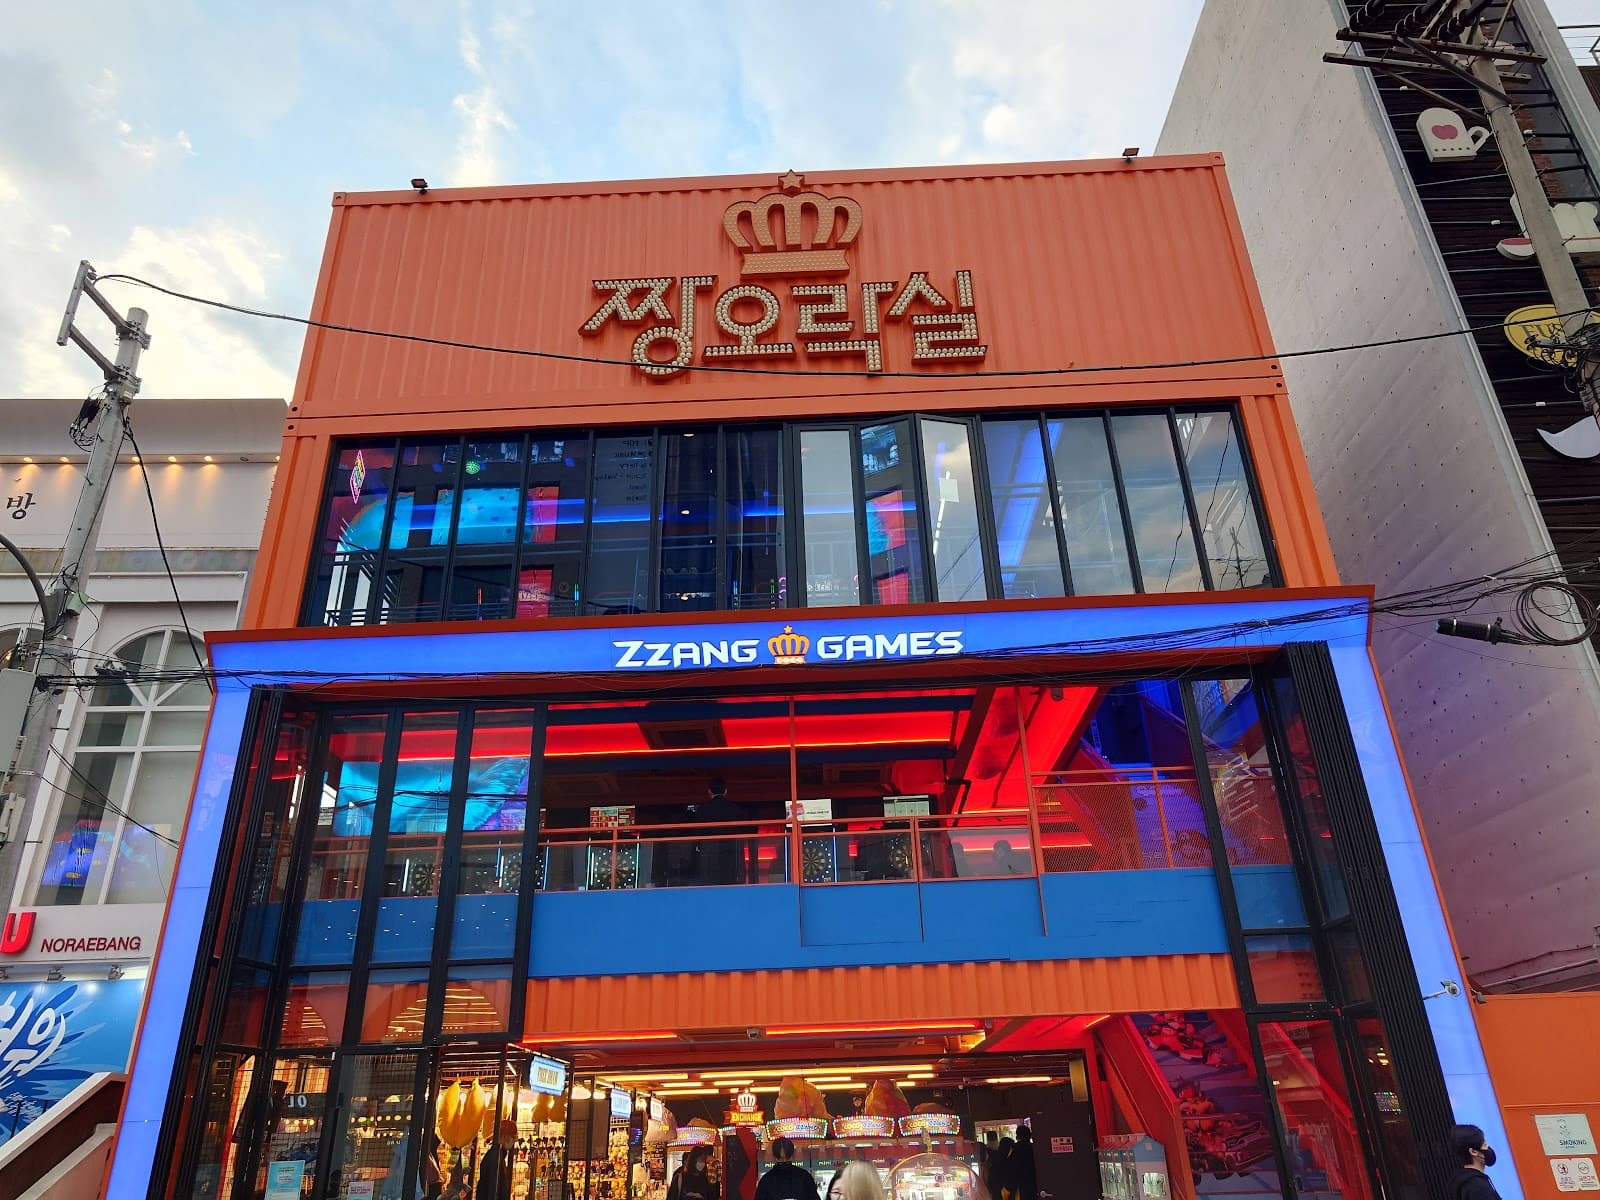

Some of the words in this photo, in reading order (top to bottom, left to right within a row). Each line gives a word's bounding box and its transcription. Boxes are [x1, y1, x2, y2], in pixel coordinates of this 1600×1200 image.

[578, 269, 988, 380] 짱오락실
[6, 492, 37, 520] 방
[612, 639, 760, 669] ZZANG
[816, 631, 964, 661] GAMES
[40, 936, 142, 953] NORAEBANG
